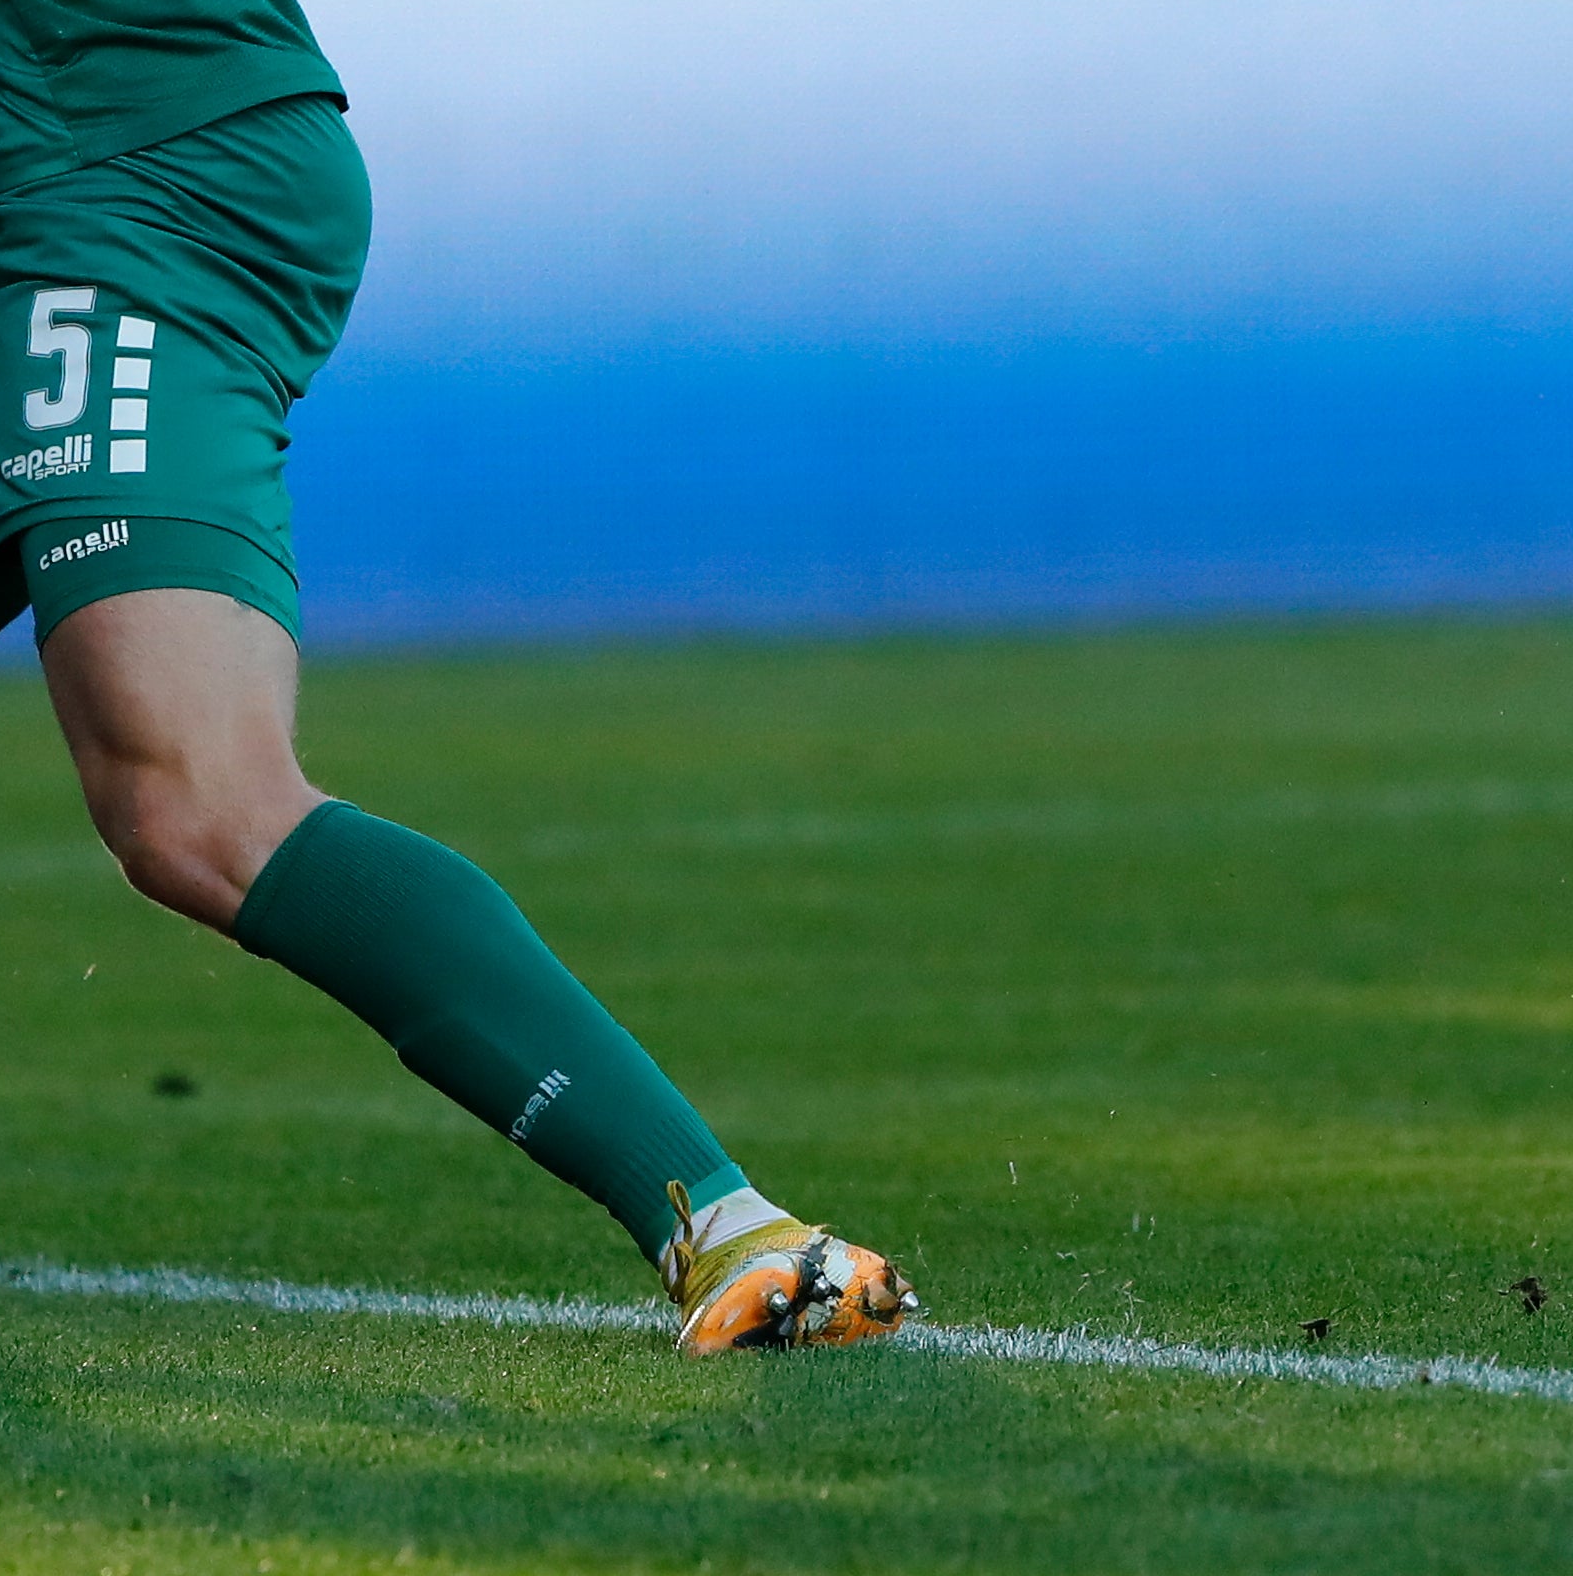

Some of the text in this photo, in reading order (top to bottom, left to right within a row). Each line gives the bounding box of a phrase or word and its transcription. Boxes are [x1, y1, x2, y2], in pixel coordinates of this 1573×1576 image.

[22, 285, 98, 432] 5
[0, 433, 94, 480] capelli
[33, 461, 92, 481] SPORT
[39, 519, 131, 571] capelli
[76, 537, 131, 560] SPORT
